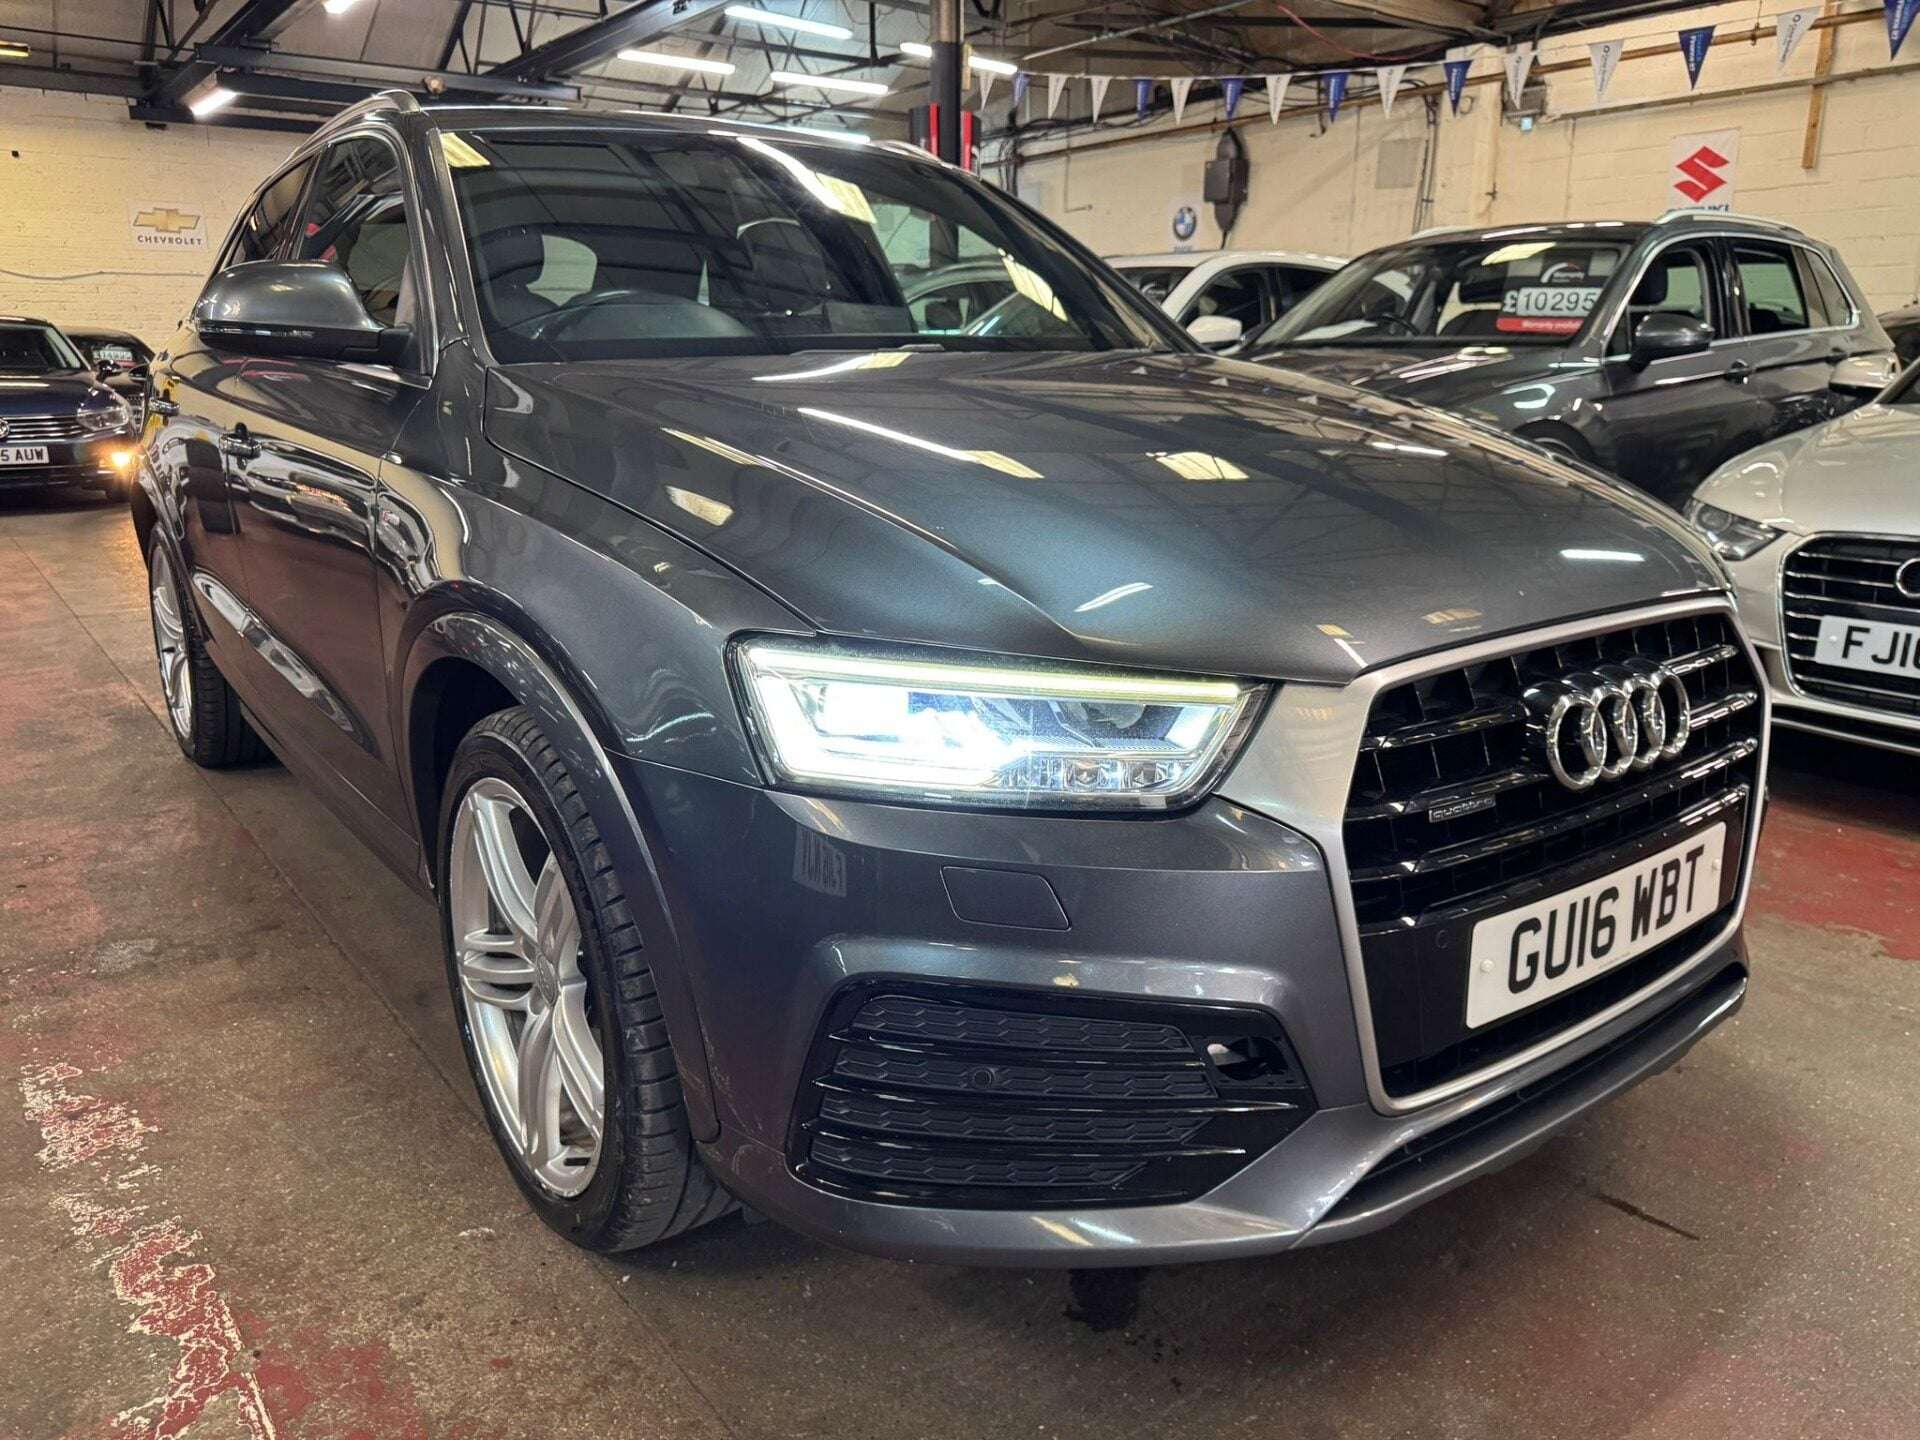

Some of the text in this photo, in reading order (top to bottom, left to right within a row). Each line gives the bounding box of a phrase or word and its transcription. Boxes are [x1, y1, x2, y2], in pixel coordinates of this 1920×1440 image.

[137, 235, 203, 246] CHEVROLET
[15, 448, 45, 462] AUW
[1508, 844, 1705, 994] GU16 WBT
